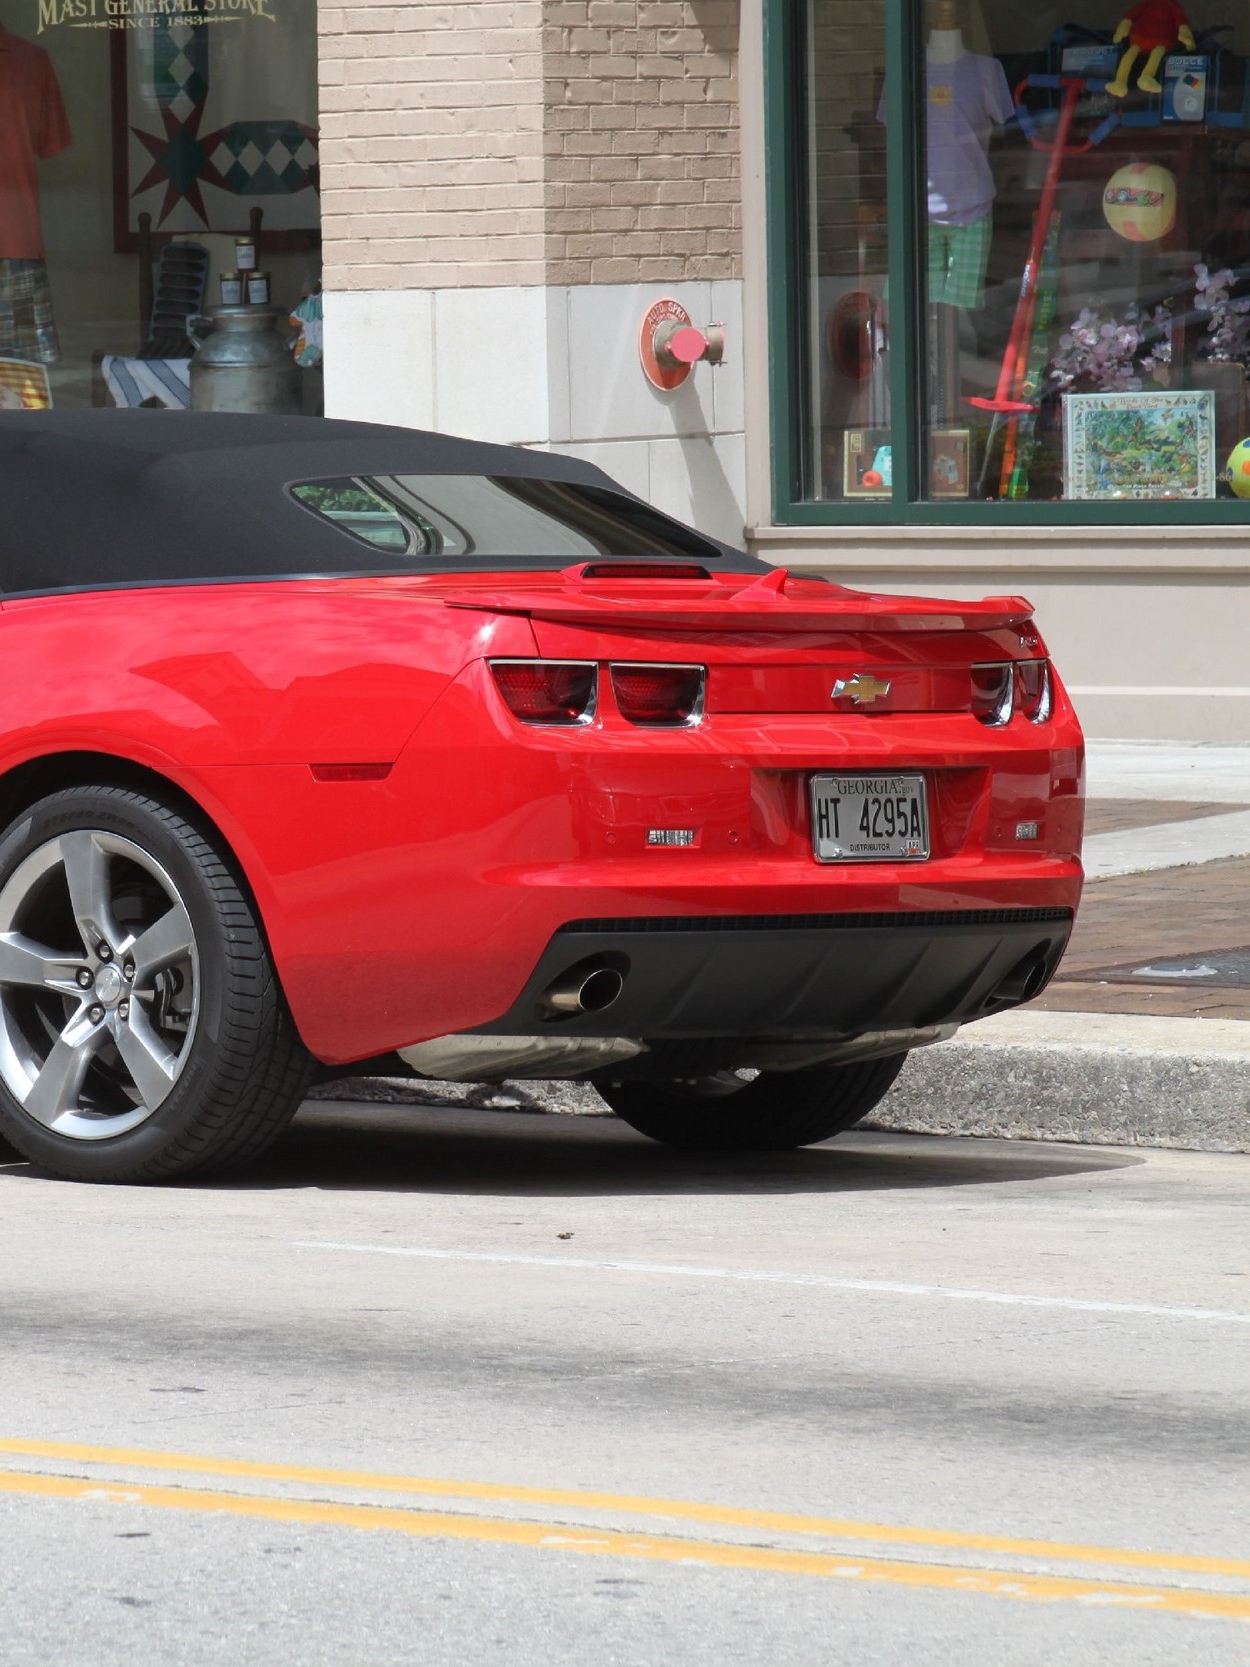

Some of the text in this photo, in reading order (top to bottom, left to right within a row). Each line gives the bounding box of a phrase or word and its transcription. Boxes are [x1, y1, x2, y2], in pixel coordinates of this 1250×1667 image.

[36, 0, 276, 35] MAST GENERAL STORE
[108, 16, 204, 29] SINCE 1883
[817, 797, 922, 839] HT 4295A
[850, 843, 890, 852] DISTRIBUTOR
